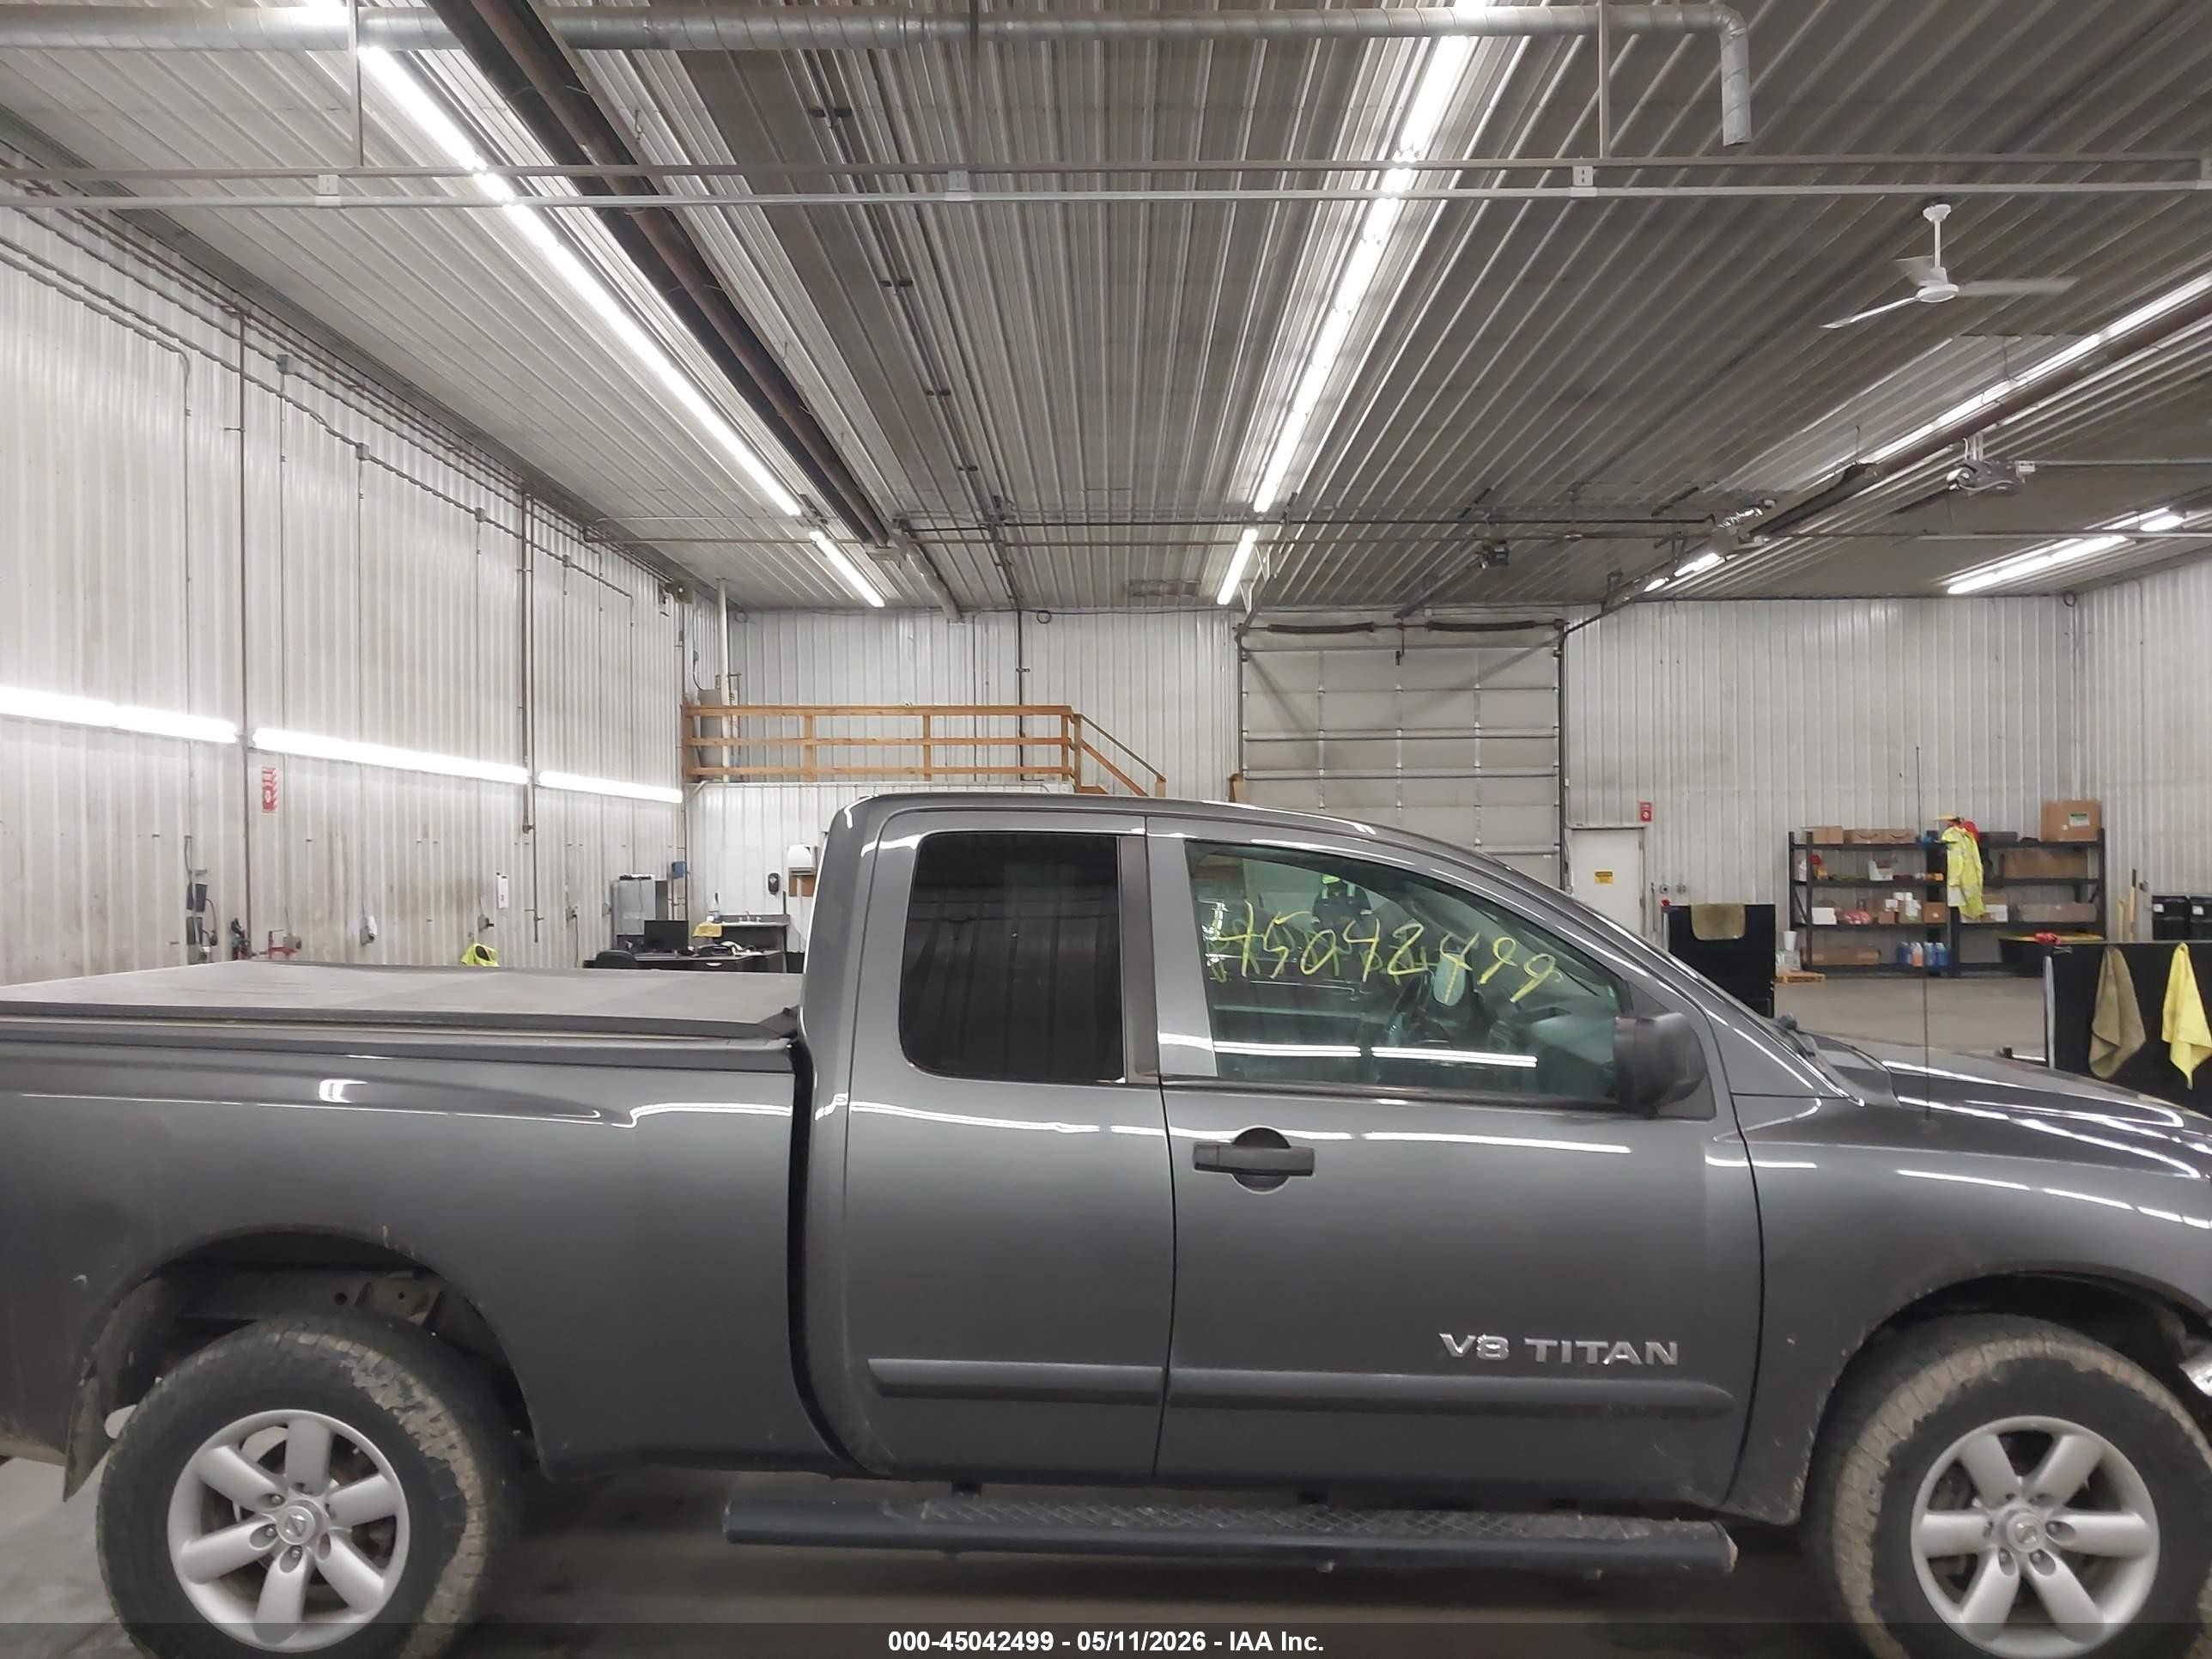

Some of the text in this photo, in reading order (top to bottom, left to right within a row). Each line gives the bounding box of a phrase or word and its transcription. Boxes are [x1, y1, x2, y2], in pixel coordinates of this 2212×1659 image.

[1207, 900, 1563, 1004] 45042499
[1438, 1333, 1679, 1365] V8 TITAN
